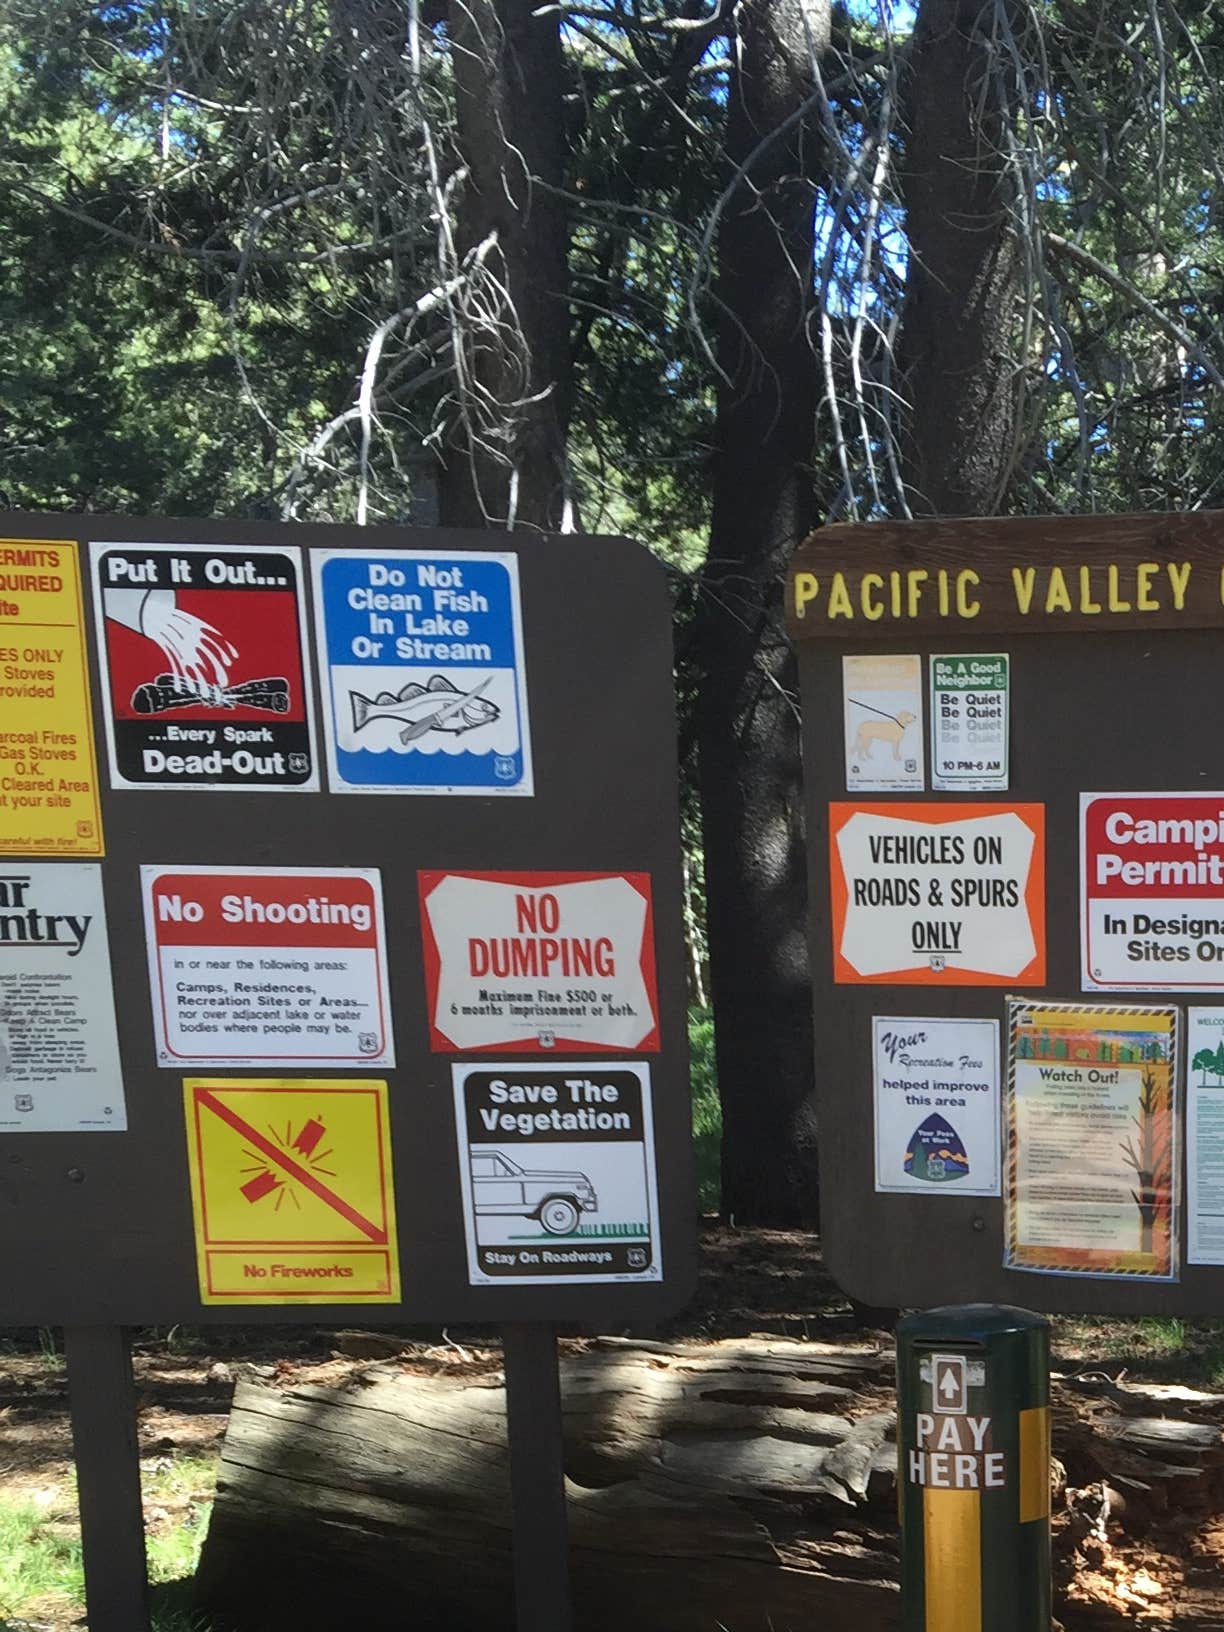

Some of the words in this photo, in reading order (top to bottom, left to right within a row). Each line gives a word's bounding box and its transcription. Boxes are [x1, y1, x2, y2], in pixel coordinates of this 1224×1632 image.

[108, 557, 158, 582] Put
[171, 559, 192, 582] It
[205, 559, 287, 585] Out...
[368, 564, 406, 586] Do
[417, 565, 464, 587] Not
[348, 589, 422, 611] Clean
[433, 590, 489, 612] Fish
[795, 569, 980, 621] PACIFIC
[1011, 562, 1192, 611] VALLEY
[369, 613, 394, 634] In
[406, 614, 469, 636] Lake
[351, 636, 384, 658] Or
[396, 637, 492, 660] Stream
[4, 667, 55, 680] Stoves
[936, 664, 952, 674] Be
[957, 663, 966, 673] A
[971, 663, 1001, 673] Good
[936, 674, 992, 687] Neighbor
[940, 694, 959, 704] Be
[966, 694, 1001, 705] Quiet
[941, 707, 960, 717] Be
[967, 707, 1002, 718] Quiet
[149, 726, 216, 744] ...Every
[224, 727, 273, 744] Spark
[941, 720, 960, 730] Be
[967, 720, 1001, 731] Quiet
[143, 750, 286, 775] Dead-Out
[2, 778, 54, 791] Cleared
[58, 780, 90, 792] Area
[869, 836, 964, 864] VEHICLES
[974, 836, 1002, 864] ON
[854, 878, 920, 906] ROADS
[927, 879, 943, 906] &
[951, 879, 1018, 907] SPURS
[158, 895, 204, 922] No
[221, 895, 371, 931] Shooting
[515, 894, 560, 934] NO
[1104, 914, 1127, 934] In
[912, 921, 962, 949] ONLY
[468, 937, 616, 977] DUMPING
[1127, 941, 1190, 962] Sites
[176, 982, 228, 994] Camps,
[234, 982, 316, 994] Residences,
[479, 989, 534, 1002] Maximum
[538, 990, 561, 1002] Fine
[566, 990, 596, 1003] $500
[601, 992, 613, 1003] or
[177, 996, 251, 1006] Recreation
[258, 997, 291, 1006] Sites
[298, 998, 311, 1006] or
[451, 1003, 458, 1016] 6
[462, 1004, 503, 1016] months
[510, 1004, 586, 1017] imprisonment
[591, 1006, 603, 1016] or
[179, 1010, 196, 1019] nor
[203, 1011, 227, 1020] over
[232, 1010, 280, 1021] adjacent
[285, 1010, 309, 1020] lake
[314, 1011, 325, 1020] or
[331, 1011, 361, 1020] water
[180, 1023, 218, 1033] bodies
[224, 1024, 258, 1033] where
[263, 1024, 301, 1035] people
[307, 1025, 330, 1035] may
[880, 1032, 928, 1063] Your
[883, 1079, 929, 1092] helped
[933, 1080, 989, 1092] improve
[1039, 1068, 1082, 1083] Watch
[1088, 1070, 1119, 1084] Out!
[489, 1079, 559, 1104] Save
[565, 1080, 619, 1103] The
[906, 1096, 931, 1105] this
[935, 1098, 966, 1106] area
[480, 1108, 631, 1135] Vegetation
[485, 1252, 516, 1266] Stay
[520, 1252, 540, 1263] On
[543, 1251, 612, 1264] Roadways
[244, 1265, 266, 1277] No
[271, 1264, 353, 1278] Fireworks
[917, 1413, 991, 1451] PAY
[909, 1450, 1005, 1488] HERE
